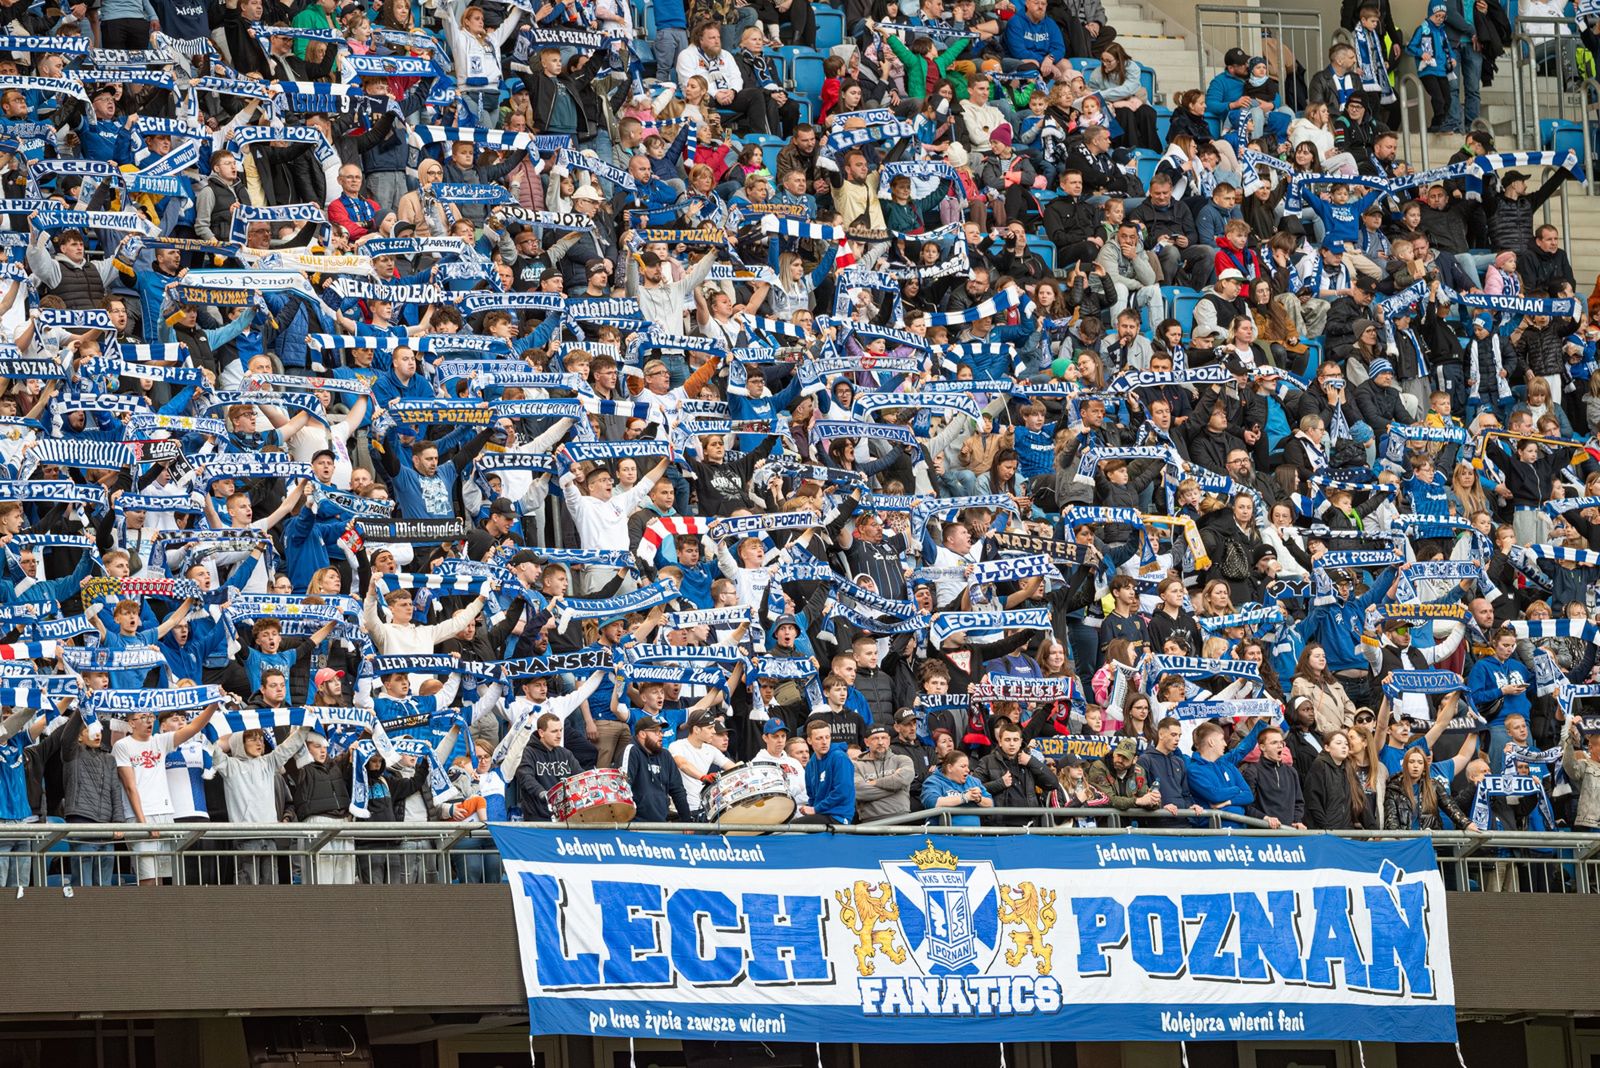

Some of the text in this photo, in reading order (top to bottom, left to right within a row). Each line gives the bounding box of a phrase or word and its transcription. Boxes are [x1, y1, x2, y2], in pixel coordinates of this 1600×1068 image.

[15, 37, 88, 52] POZNAŃ
[60, 70, 172, 84] AKONIEWICE
[340, 95, 350, 112] 9
[61, 213, 86, 225] LECH
[647, 229, 677, 242] LECH
[390, 240, 410, 250] LECH
[184, 289, 207, 302] LECH
[472, 295, 504, 307] LECH
[1491, 297, 1544, 312] POZNAŃ
[442, 362, 525, 376] FORZA LECH
[1115, 372, 1175, 393] LECH
[63, 393, 140, 409] LECH
[401, 409, 431, 423] LECH
[823, 425, 861, 438] LECH
[573, 446, 612, 461] LECH
[1096, 445, 1169, 458] KOLEJORZ
[328, 491, 351, 508] LECH
[735, 520, 761, 534] LECH
[996, 534, 1079, 559] MAJSTER
[979, 556, 1048, 581] LECH
[120, 583, 174, 594] CRACOVIA
[573, 598, 605, 610] LECH
[1385, 603, 1415, 617] LECH
[936, 612, 990, 635] LECH
[637, 645, 671, 658] LECH
[377, 656, 406, 669] LECH
[625, 664, 720, 685] Poznański Lech
[1396, 672, 1423, 689] LECH
[93, 690, 200, 712] Nasz Kolejorz
[557, 838, 614, 861] Jednym
[619, 836, 675, 859] herbem
[1096, 843, 1306, 867] jednym barwom wciąż oddani
[922, 873, 964, 884] KKS LECH
[518, 858, 1438, 1002] LECH POZNAŃ
[857, 974, 1064, 1019] FANATICS
[589, 1006, 787, 1035] po kres życia zawsze wierni
[1160, 1009, 1306, 1038] Kolejorza wierni fani
